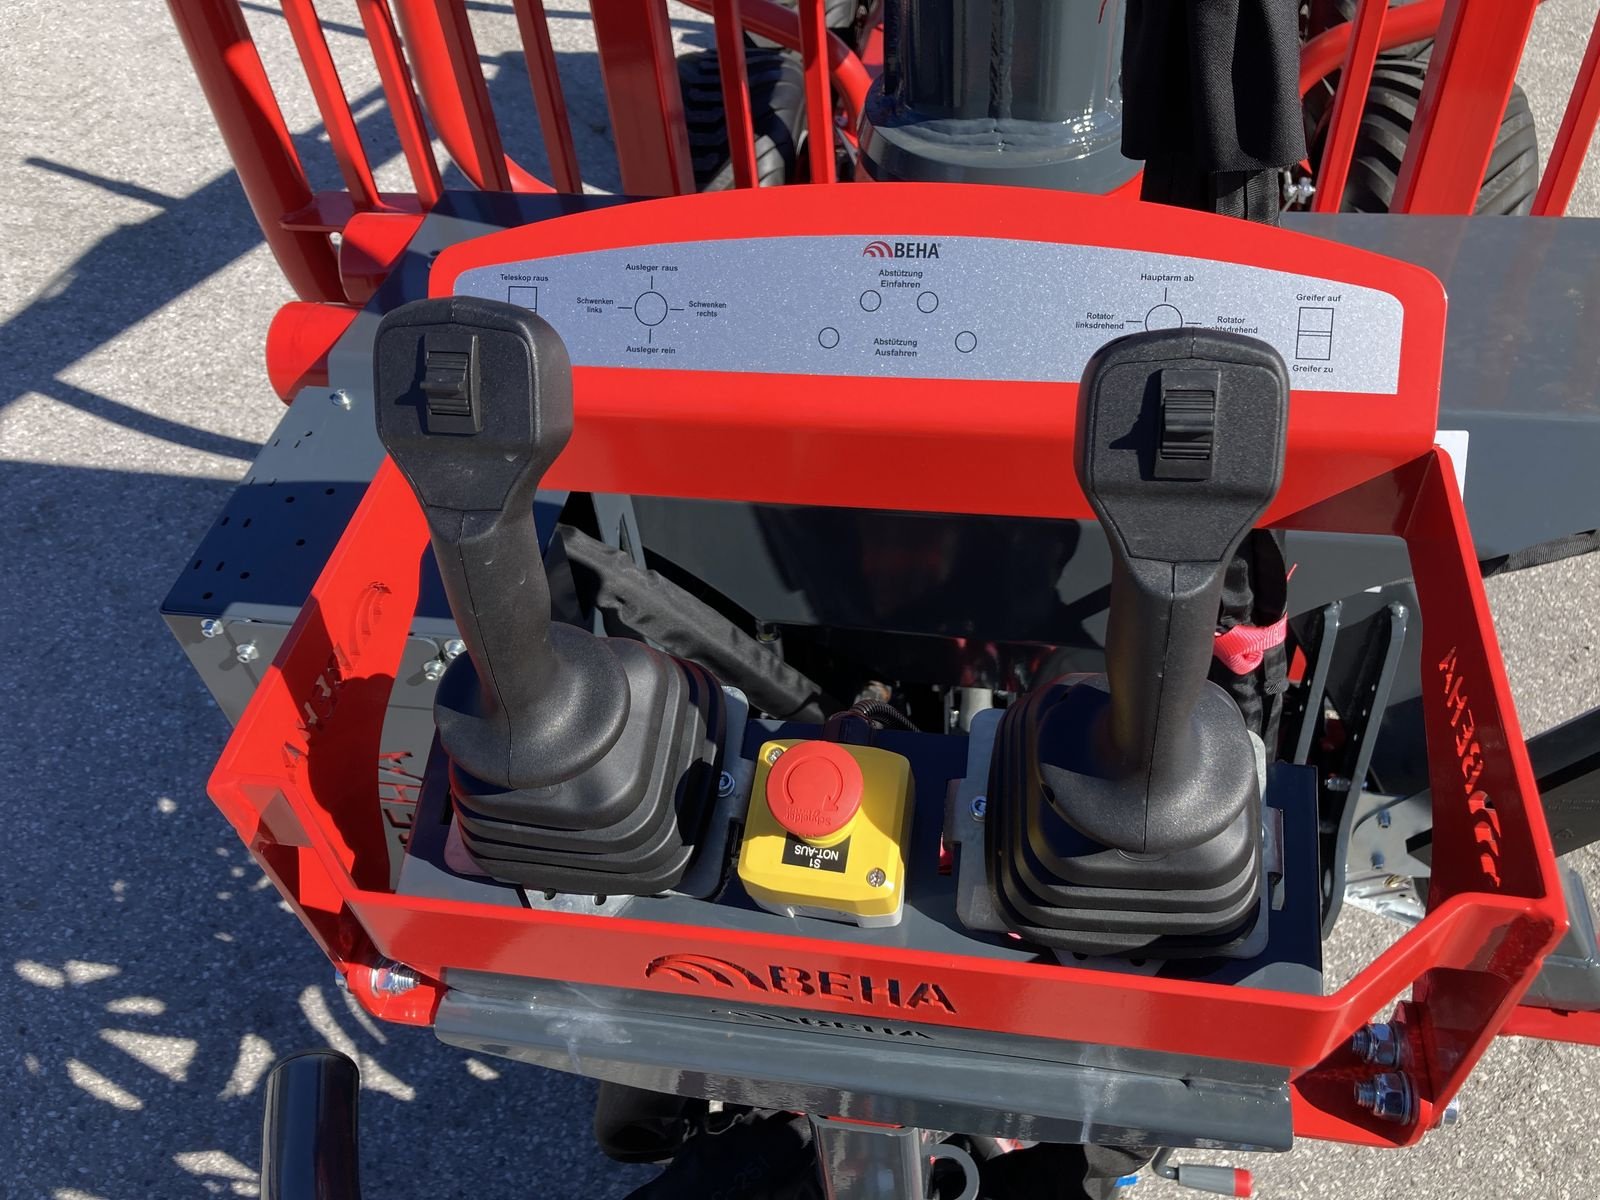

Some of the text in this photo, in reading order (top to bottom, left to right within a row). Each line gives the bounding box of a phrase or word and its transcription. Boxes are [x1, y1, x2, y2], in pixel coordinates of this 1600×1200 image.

[894, 242, 940, 259] BEHA
[625, 263, 659, 273] Ausleger
[500, 273, 532, 283] Teleskop
[878, 269, 924, 279] Abstützung
[1140, 273, 1195, 282] Hauptarm ab
[880, 280, 921, 289] Einfahren
[576, 296, 614, 305] Schwenken
[1295, 293, 1342, 302] Greifer auf
[688, 300, 727, 309] Schwenken
[586, 306, 603, 314] links
[696, 310, 718, 318] rechts
[1086, 311, 1115, 320] Rotator
[1216, 315, 1246, 324] Rotator
[1075, 320, 1124, 330] linksdrehend
[873, 337, 918, 347] Abstützung
[625, 345, 676, 354] Ausleger rein
[874, 348, 918, 358] Ausfahren
[1292, 364, 1321, 372] Greifer
[793, 844, 839, 862] NOT-AUS
[808, 857, 822, 869] S1
[767, 964, 957, 1015] BEHA
